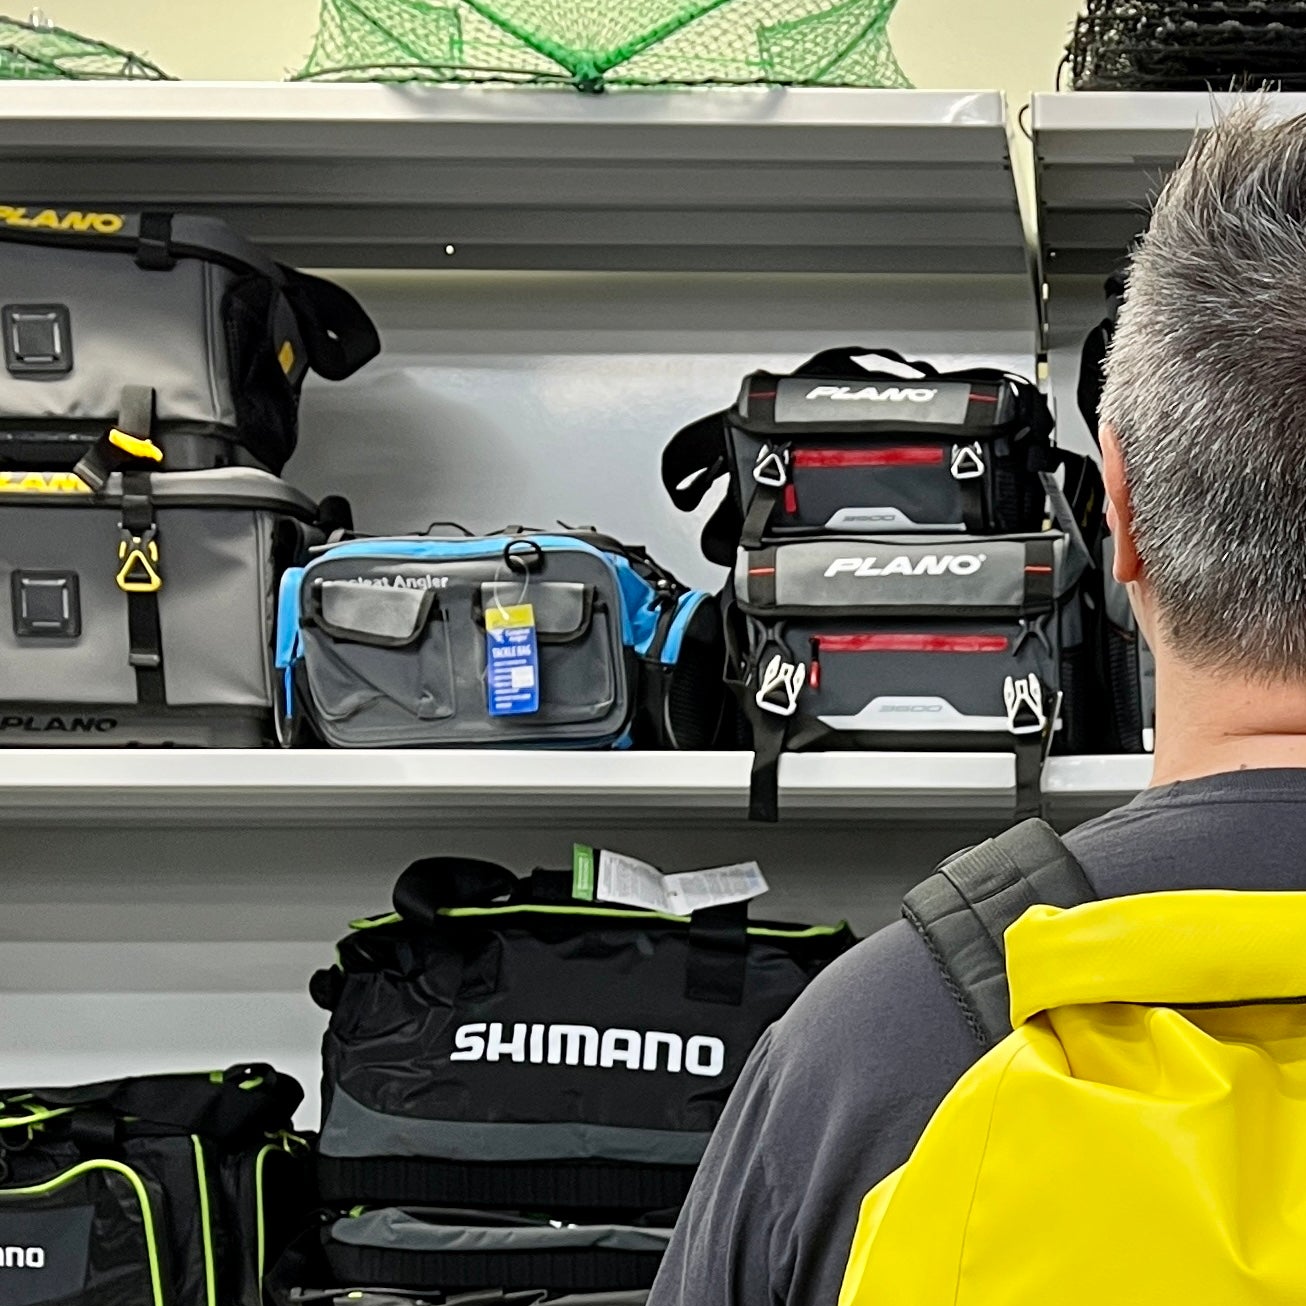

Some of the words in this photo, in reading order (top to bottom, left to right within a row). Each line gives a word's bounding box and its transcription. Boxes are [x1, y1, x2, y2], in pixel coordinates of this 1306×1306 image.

[805, 386, 937, 402] PLANO
[823, 554, 987, 577] PLANO
[393, 574, 449, 589] Angler
[0, 715, 118, 733] PLANO
[450, 1022, 725, 1077] SHIMANO
